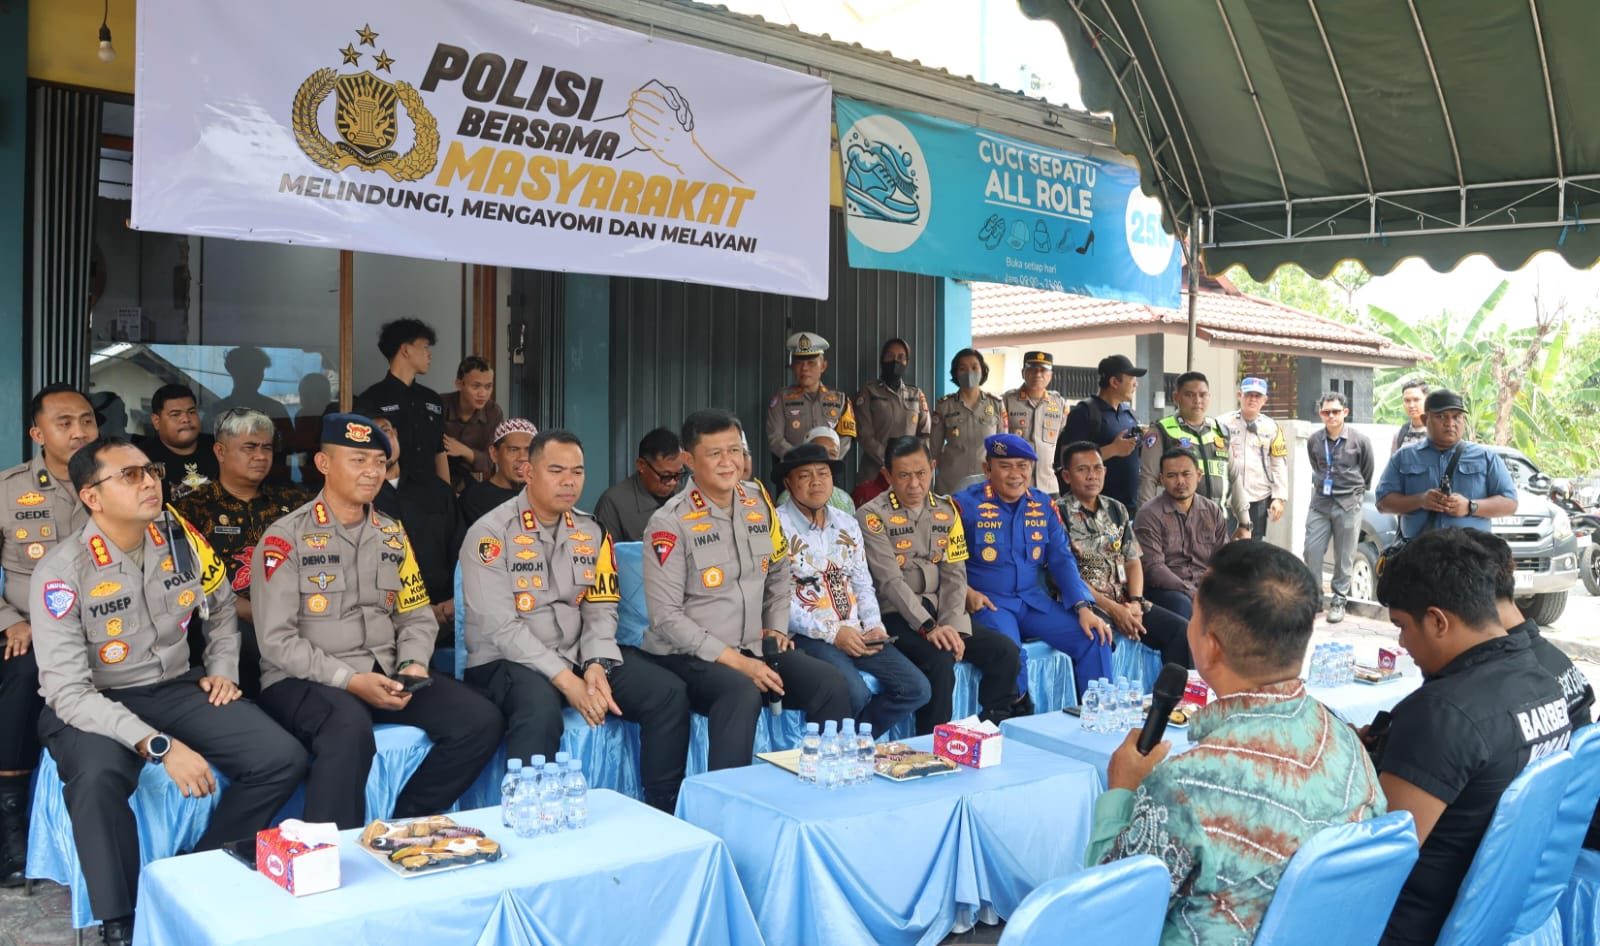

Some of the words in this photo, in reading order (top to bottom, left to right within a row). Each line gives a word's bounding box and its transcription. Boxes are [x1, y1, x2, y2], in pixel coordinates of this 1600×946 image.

[420, 43, 604, 122] POLISI
[457, 108, 621, 160] BERSAMA
[979, 140, 1024, 170] CUCI
[1029, 157, 1097, 187] SEPATU
[435, 142, 756, 229] MASYARAKAT
[985, 169, 1030, 206] ALL
[1036, 183, 1094, 218] ROLE
[278, 173, 455, 219] MELINDUNGI,
[461, 202, 603, 235] MENGAYOMI
[609, 219, 657, 242] DAN
[661, 225, 757, 254] MELAYANI
[15, 510, 50, 520] GEDE
[748, 524, 768, 534] POLRI
[976, 521, 1003, 529] DONY
[694, 532, 720, 547] IWAN
[164, 570, 196, 590] POLRI
[89, 596, 132, 618] YUSEP
